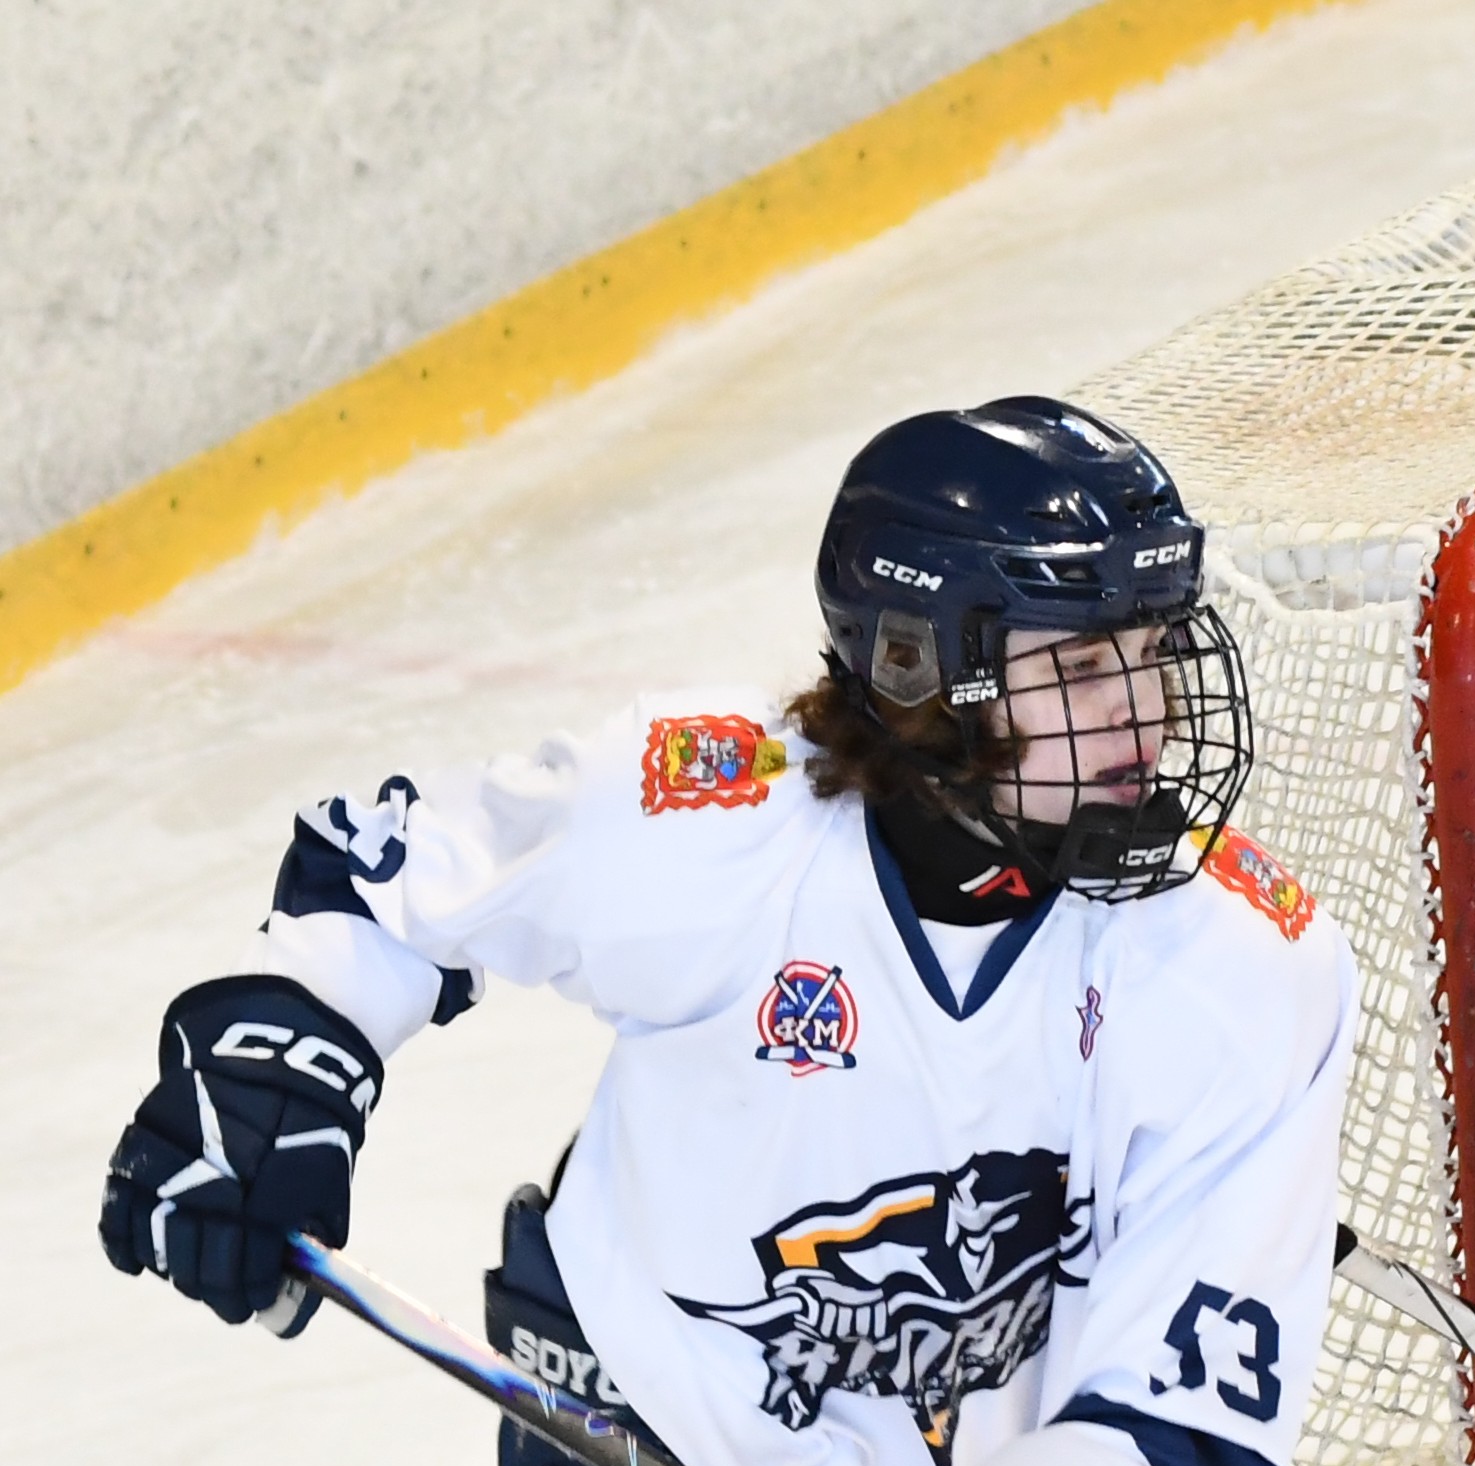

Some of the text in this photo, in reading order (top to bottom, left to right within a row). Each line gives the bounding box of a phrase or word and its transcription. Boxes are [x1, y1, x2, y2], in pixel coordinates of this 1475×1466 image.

[1134, 540, 1192, 569] CCM
[872, 556, 943, 592] CCM
[951, 687, 998, 705] CCM
[1150, 1280, 1281, 1422] 53
